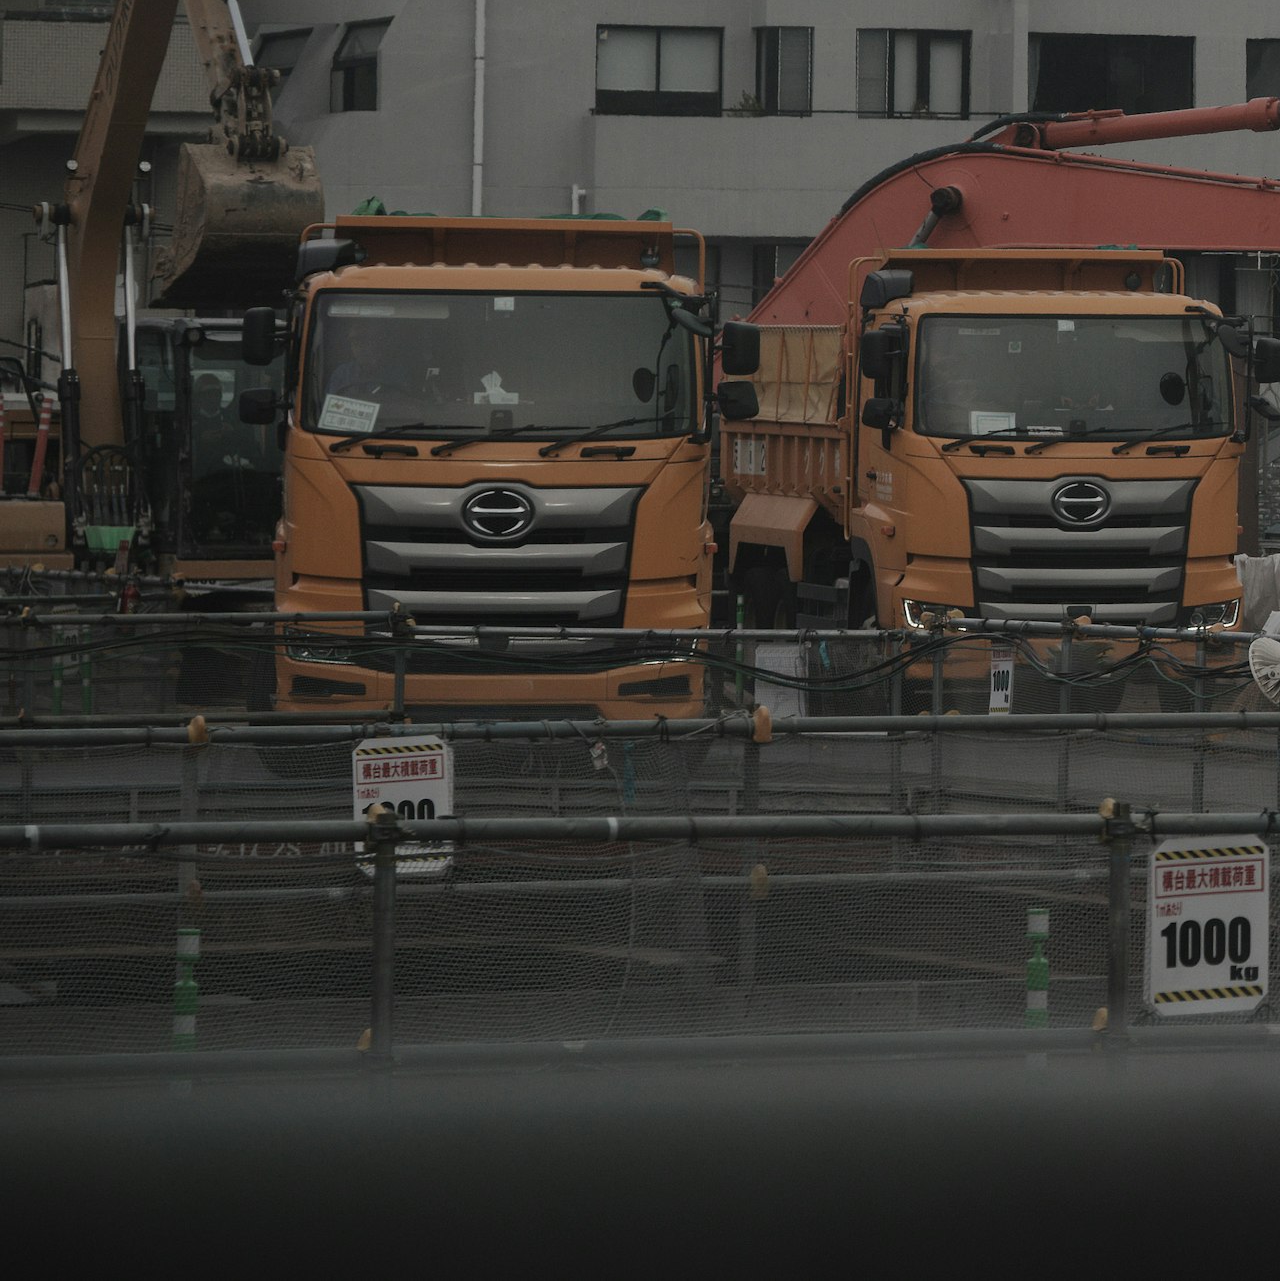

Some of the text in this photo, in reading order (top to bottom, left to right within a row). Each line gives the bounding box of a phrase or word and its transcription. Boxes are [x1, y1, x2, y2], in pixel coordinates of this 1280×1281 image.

[362, 759, 438, 779] 構台最大積載荷重
[1162, 864, 1256, 892] 構台最大積載荷重
[1161, 917, 1251, 968] 1000
[1230, 965, 1259, 982] kg
